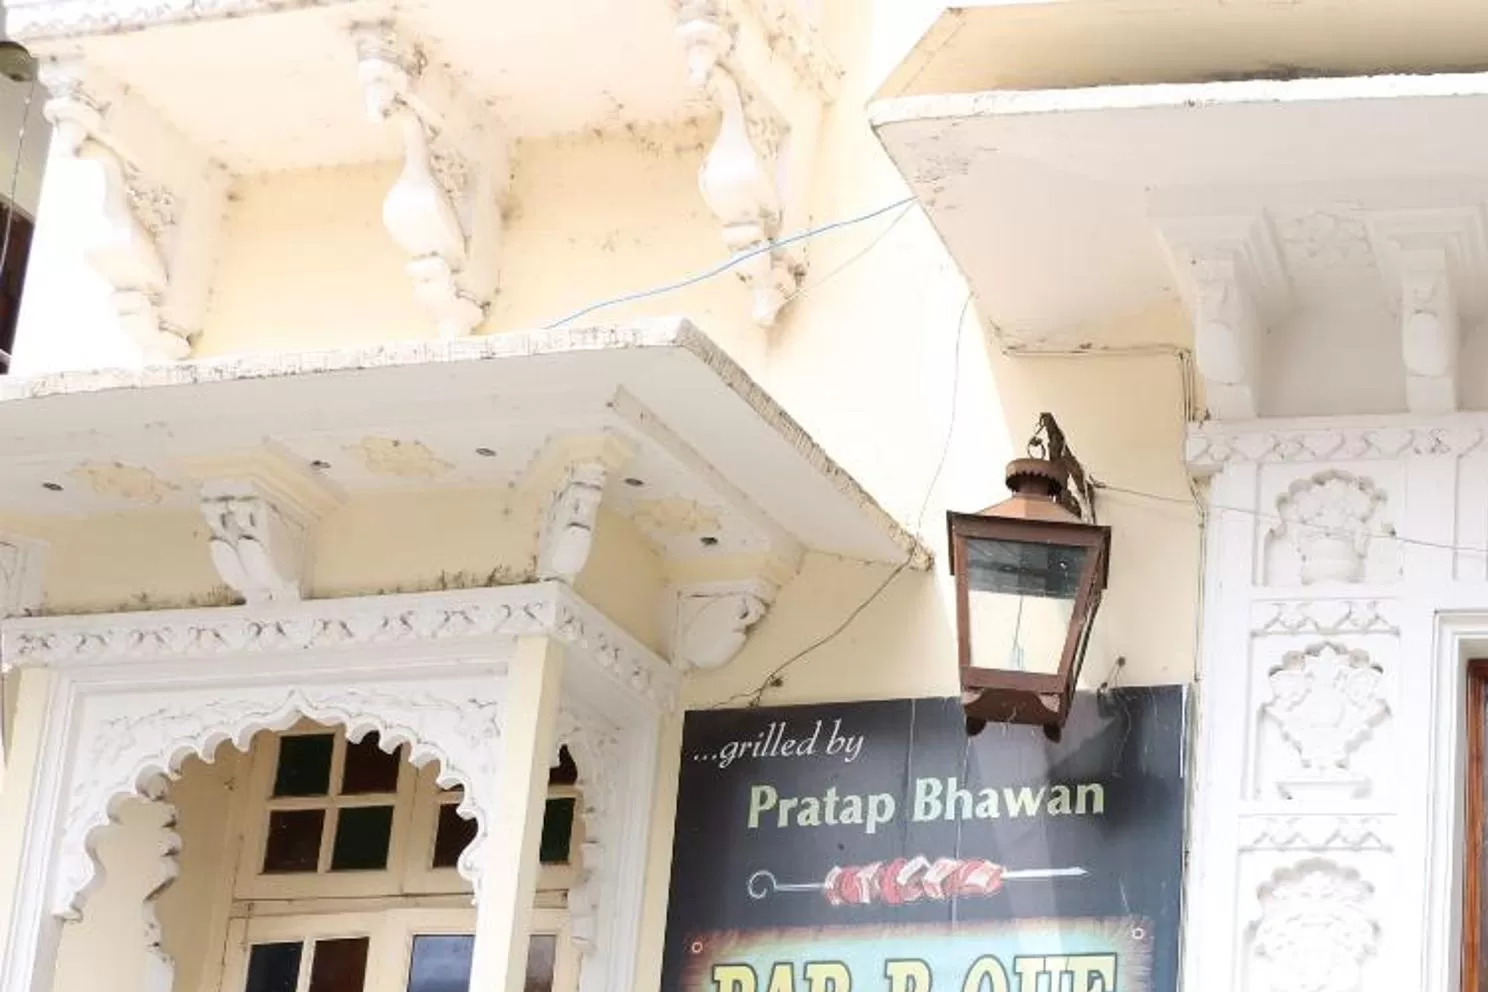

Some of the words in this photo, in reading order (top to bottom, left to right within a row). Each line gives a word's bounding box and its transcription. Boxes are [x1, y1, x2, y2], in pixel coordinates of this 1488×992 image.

[826, 718, 865, 763] by
[747, 785, 896, 834] Pratap
[912, 776, 1106, 823] Bhawan
